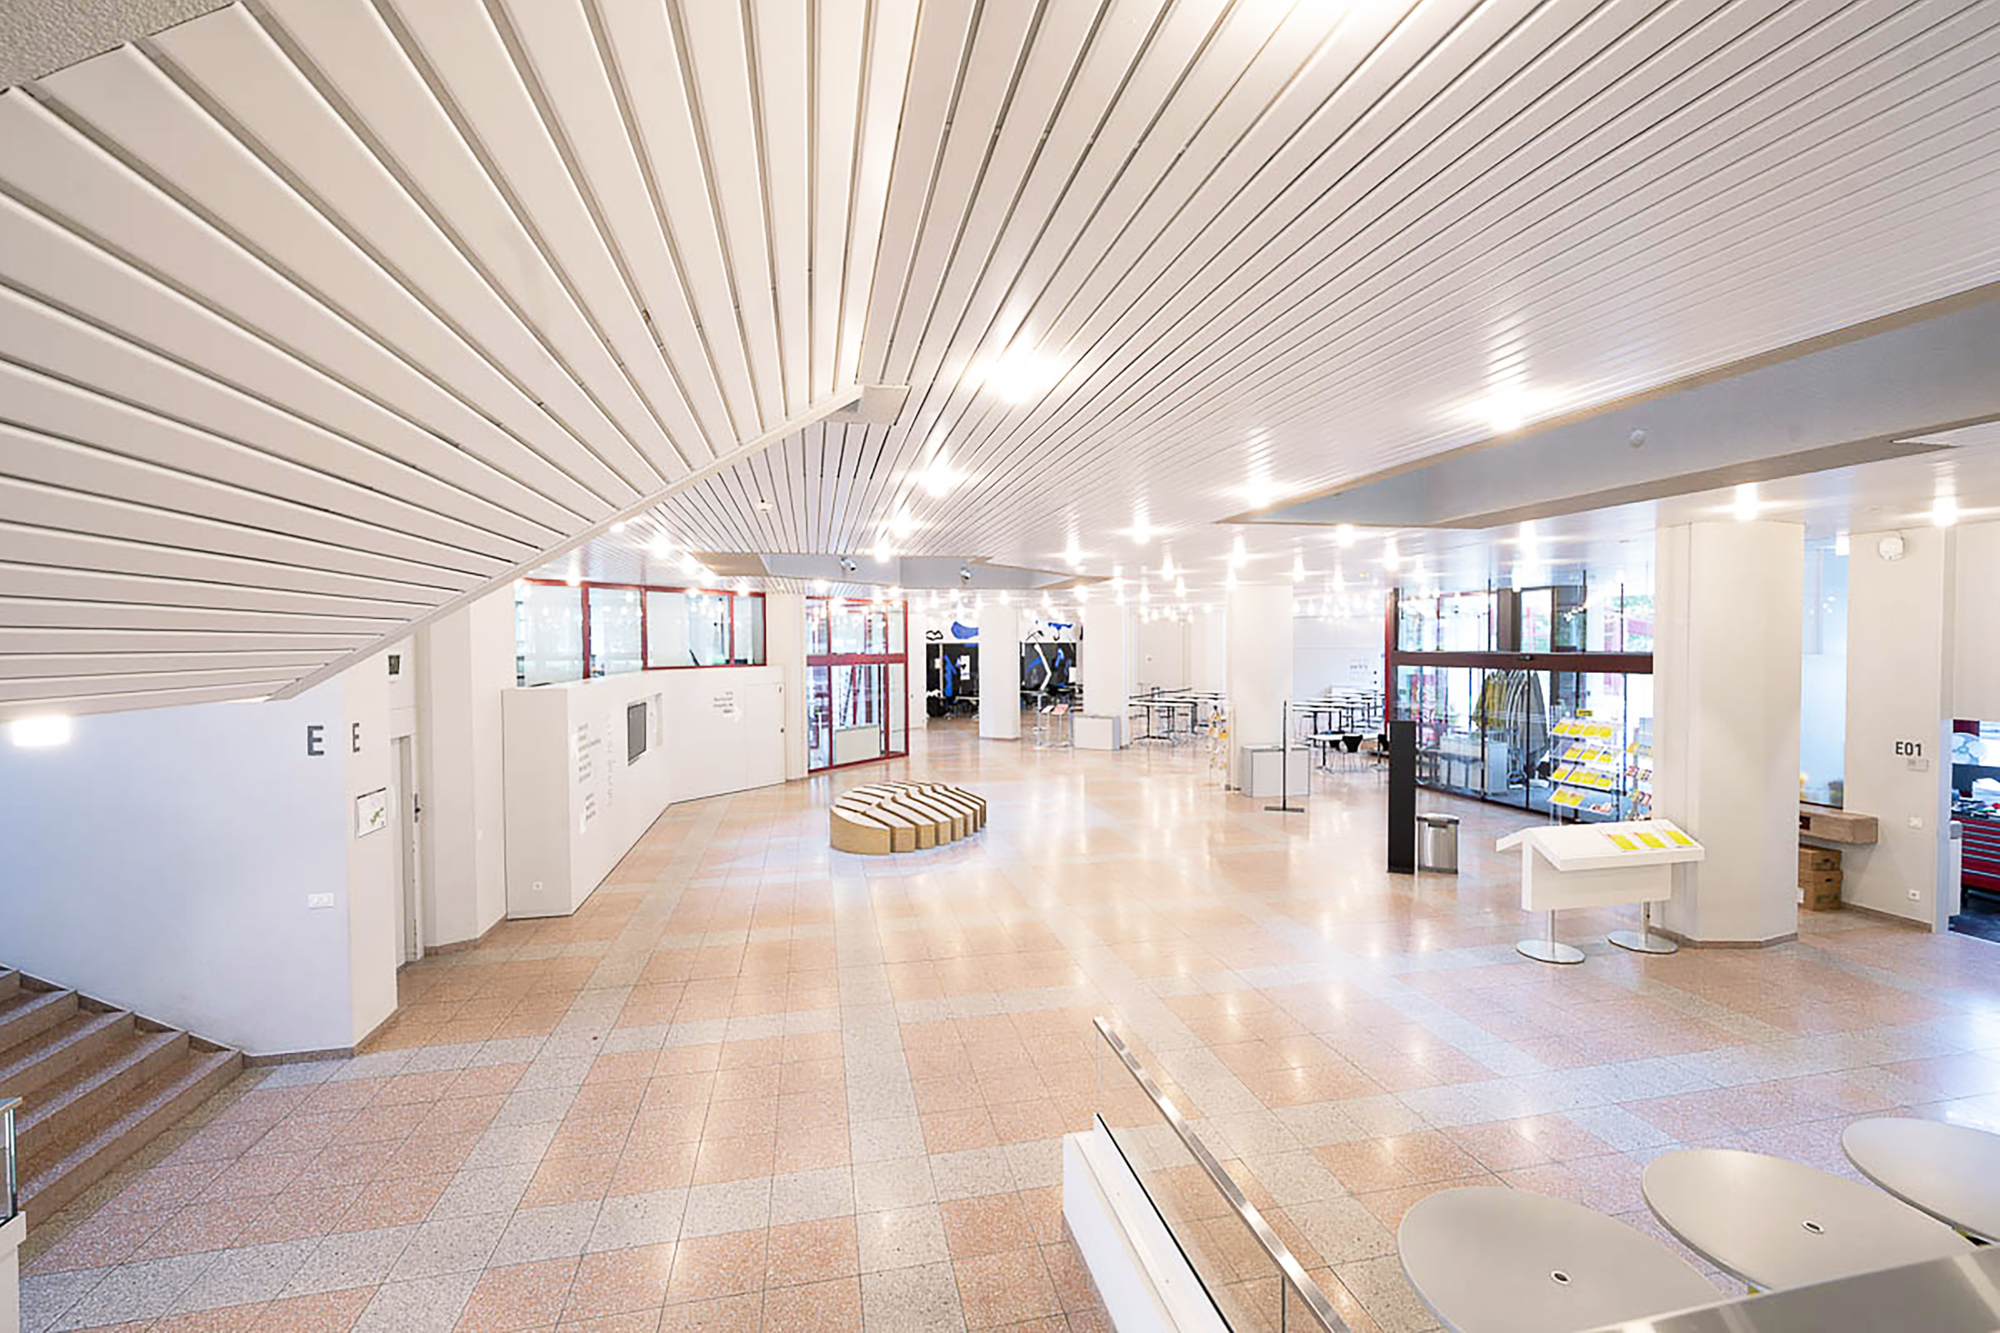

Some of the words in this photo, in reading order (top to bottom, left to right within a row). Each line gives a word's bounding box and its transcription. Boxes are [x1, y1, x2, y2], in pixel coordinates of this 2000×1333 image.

[307, 725, 324, 756] E
[352, 722, 361, 753] E
[1895, 741, 1922, 757] E01
